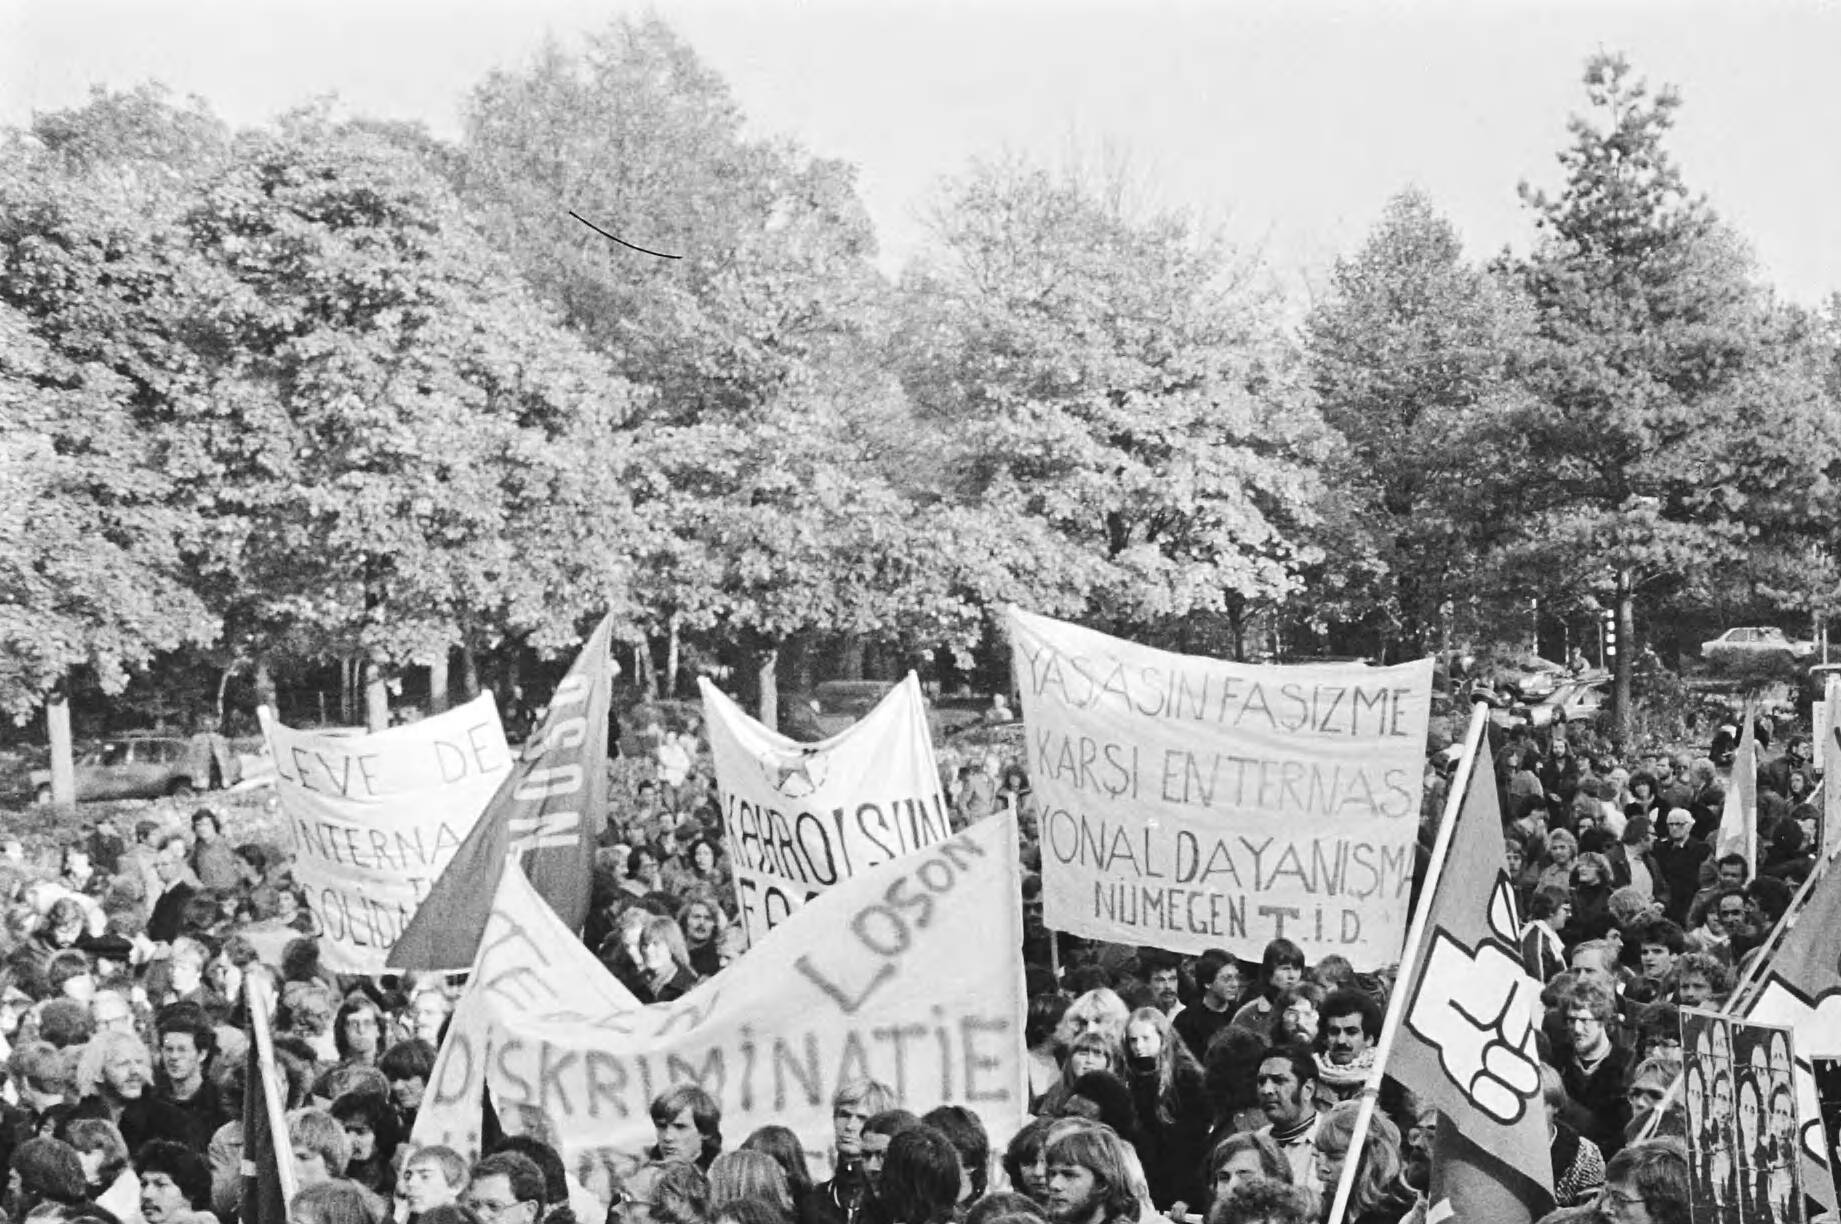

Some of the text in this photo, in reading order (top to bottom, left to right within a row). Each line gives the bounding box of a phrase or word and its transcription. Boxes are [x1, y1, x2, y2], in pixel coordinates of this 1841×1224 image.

[433, 720, 503, 785] DE
[1162, 750, 1412, 818] ENTERNAS
[794, 834, 985, 1014] LOSON
